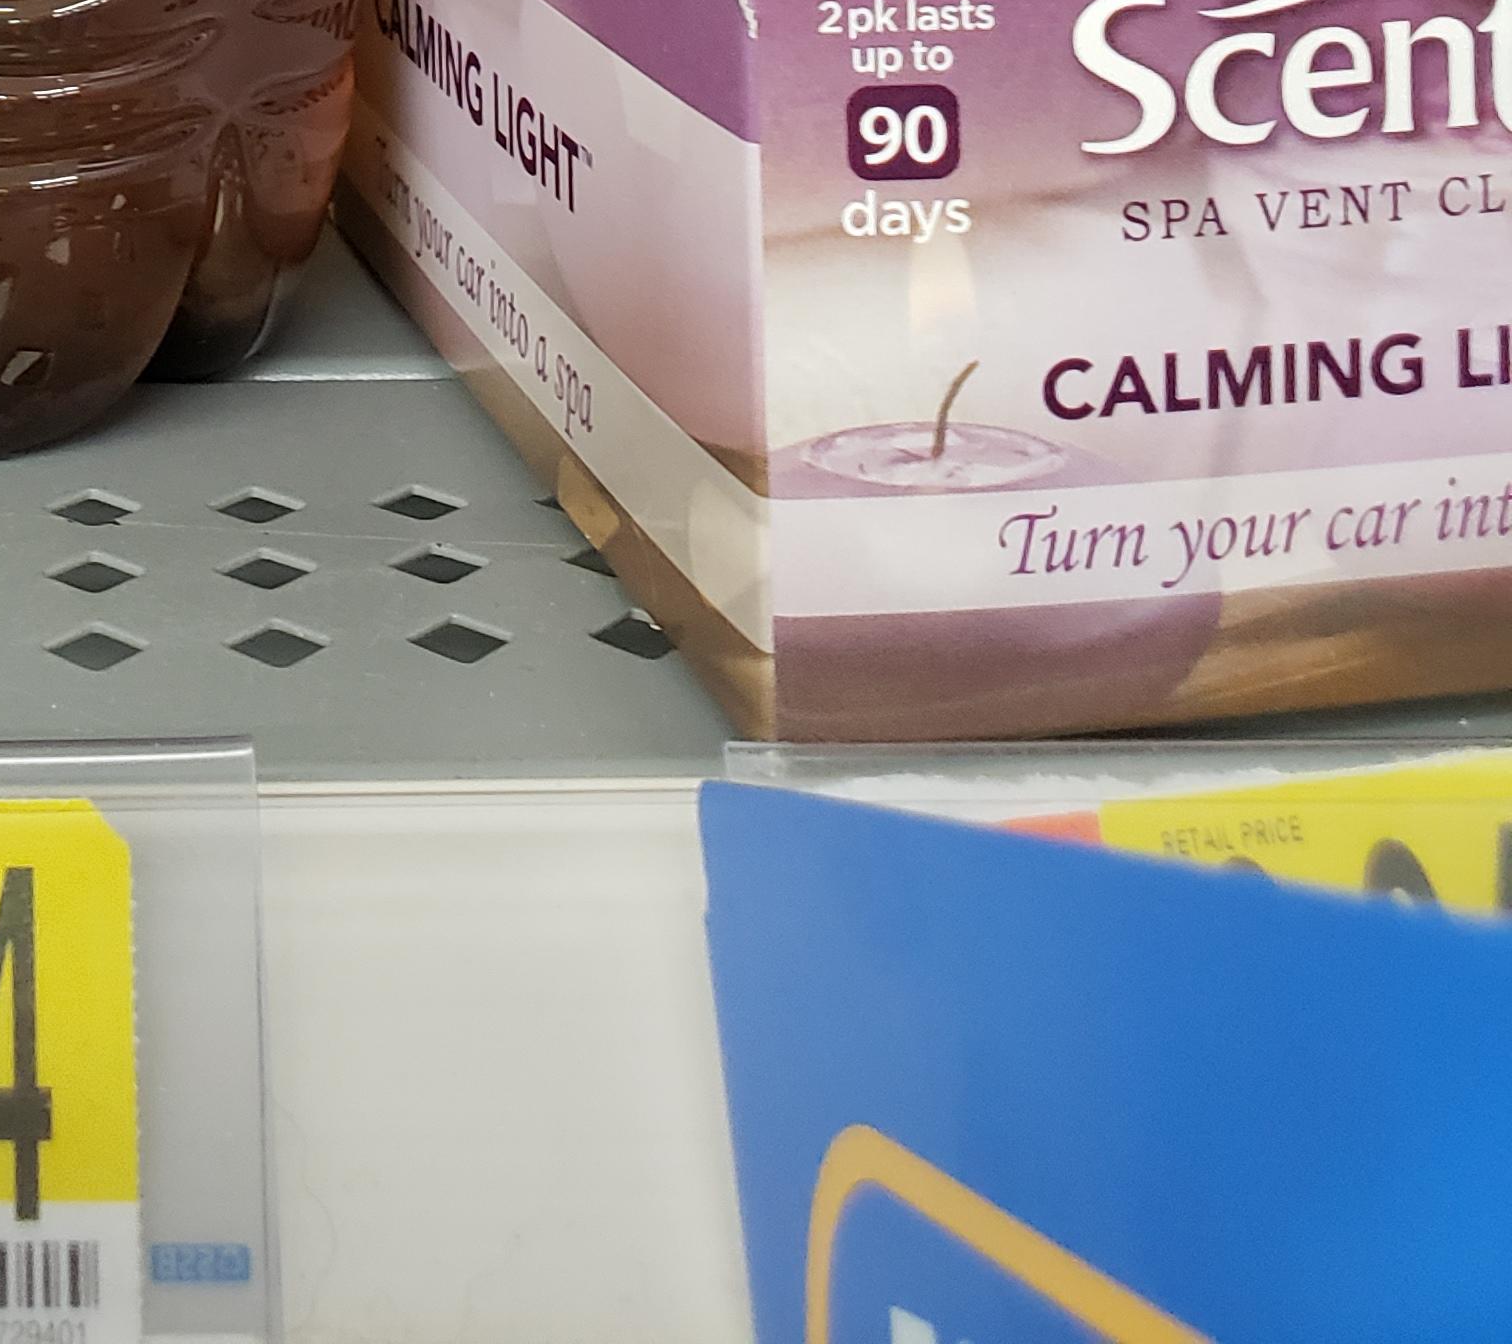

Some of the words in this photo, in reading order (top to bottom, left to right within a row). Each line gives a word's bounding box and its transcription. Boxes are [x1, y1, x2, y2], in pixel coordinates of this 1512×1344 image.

[850, 46, 903, 78] up
[910, 39, 955, 73] to
[493, 71, 581, 213] LIGHT
[857, 105, 950, 165] 90
[840, 190, 972, 243] days
[1121, 199, 1229, 243] SPA
[1257, 181, 1412, 232] VENT
[414, 194, 455, 270] your
[456, 243, 486, 305] car
[489, 258, 530, 360] into
[534, 334, 549, 384] a
[554, 351, 594, 437] spa
[1042, 332, 1425, 421] CALMING
[997, 505, 1150, 576] Turn
[1160, 506, 1312, 589] your
[1325, 496, 1423, 552] car
[1160, 827, 1235, 856] RETAIL
[1241, 815, 1304, 848] PRICE
